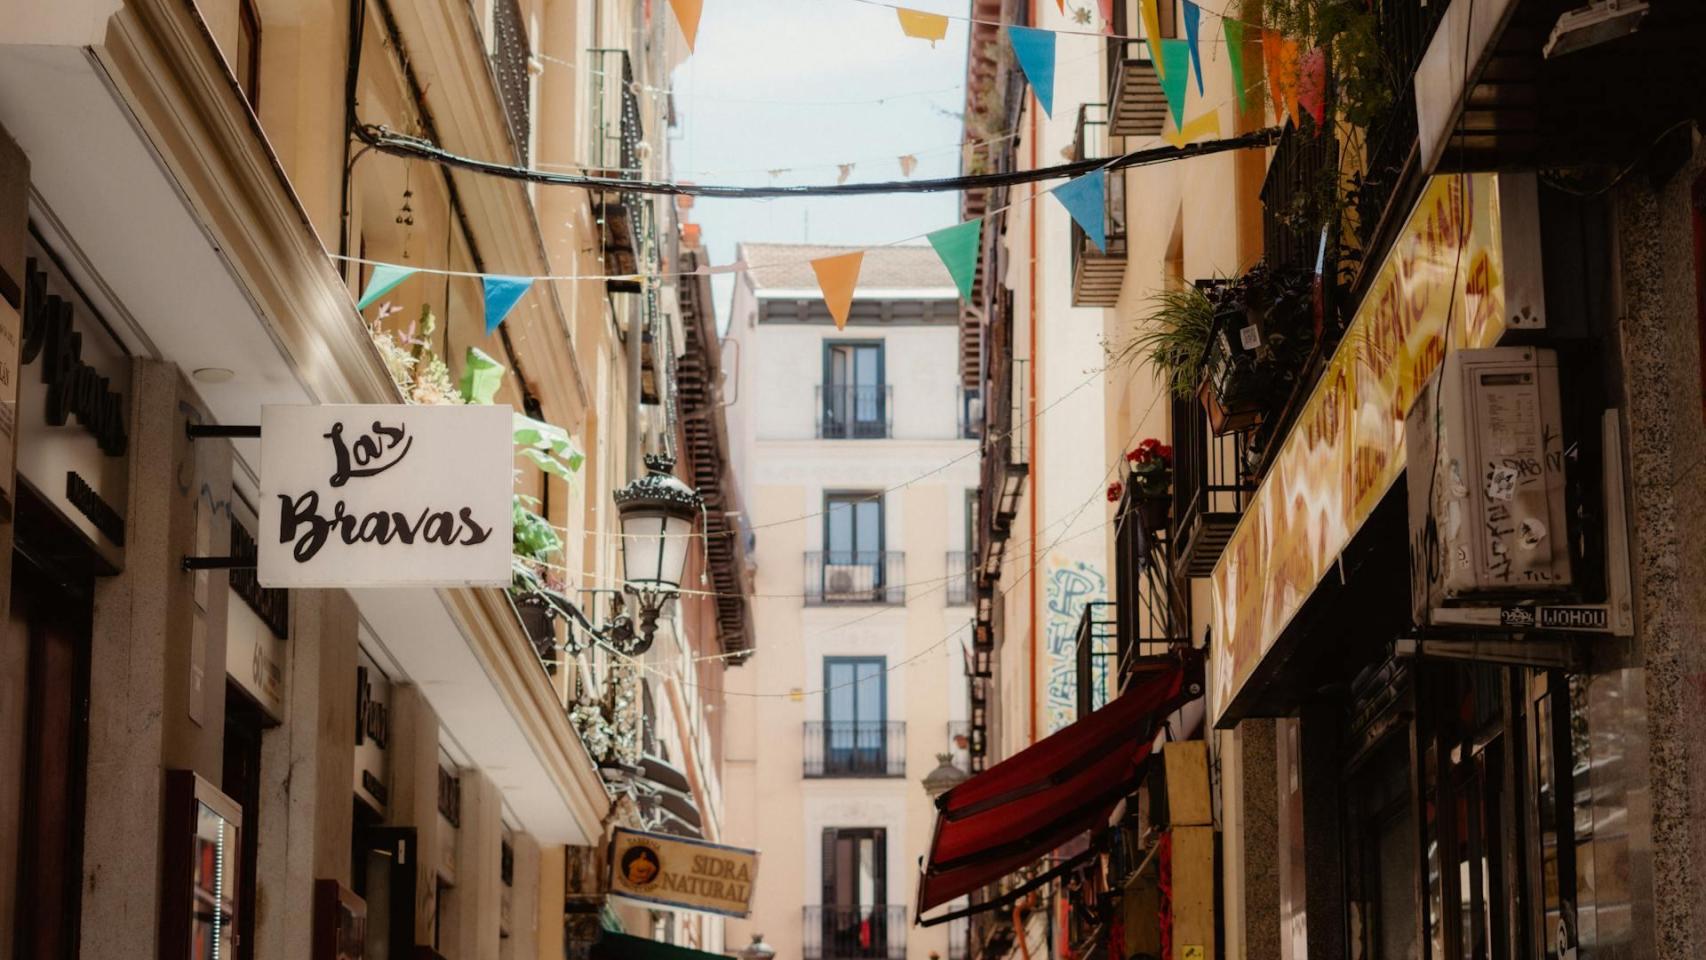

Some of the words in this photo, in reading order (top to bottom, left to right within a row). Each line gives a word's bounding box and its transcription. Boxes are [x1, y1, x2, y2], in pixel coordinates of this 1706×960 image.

[323, 420, 413, 487] Las
[277, 490, 493, 563] Bravas
[660, 871, 749, 903] NATURAL
[691, 854, 750, 882] SIDRA
